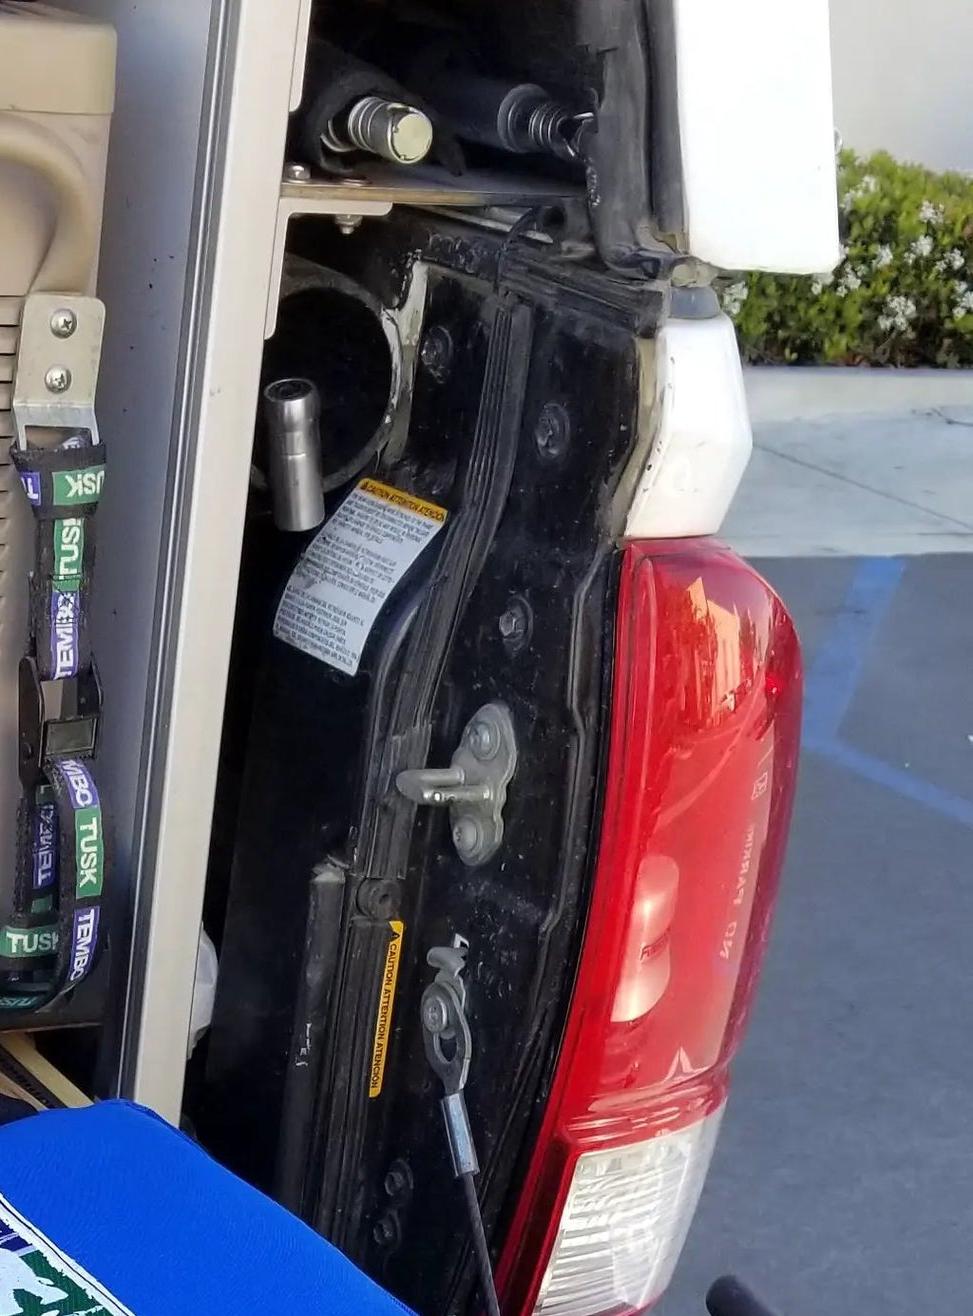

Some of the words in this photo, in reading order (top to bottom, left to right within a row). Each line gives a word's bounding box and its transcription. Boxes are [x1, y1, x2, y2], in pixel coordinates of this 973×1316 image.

[61, 760, 93, 807] MBO
[79, 816, 98, 889] TUSK
[70, 909, 95, 982] TEMBO
[384, 943, 398, 987] CAUTION
[377, 988, 394, 1040] ATTENTION
